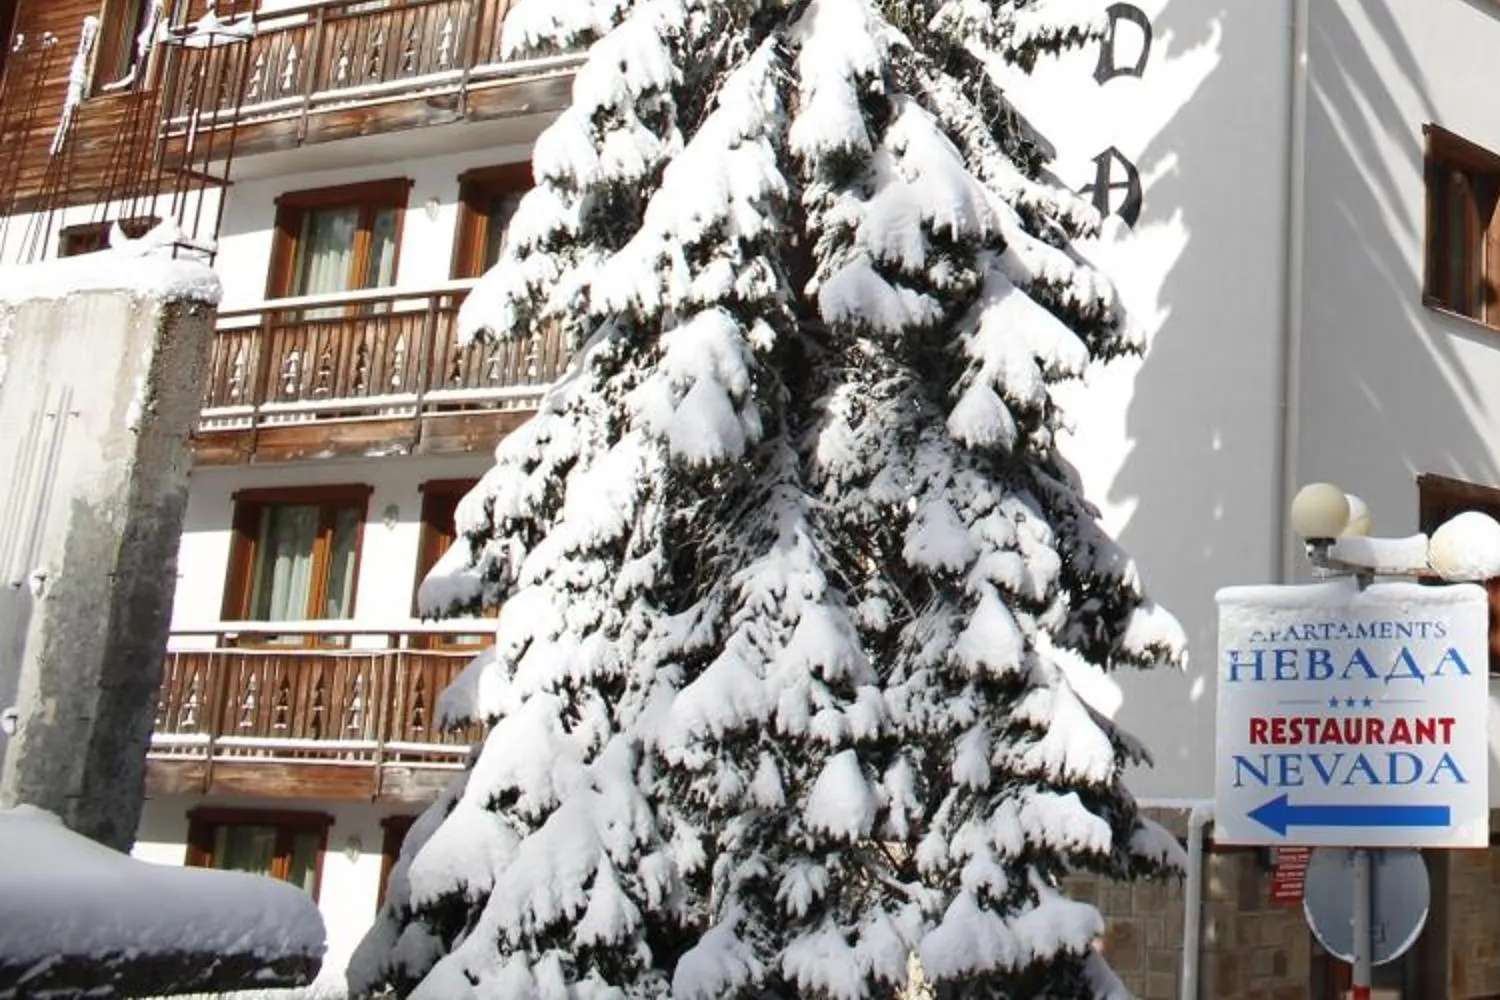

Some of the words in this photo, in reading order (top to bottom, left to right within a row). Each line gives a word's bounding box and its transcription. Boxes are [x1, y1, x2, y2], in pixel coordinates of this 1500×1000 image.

[1227, 647, 1471, 685] НЕВАДА
[1250, 717, 1456, 745] RESTAURANT
[1233, 752, 1468, 788] NEVADA
